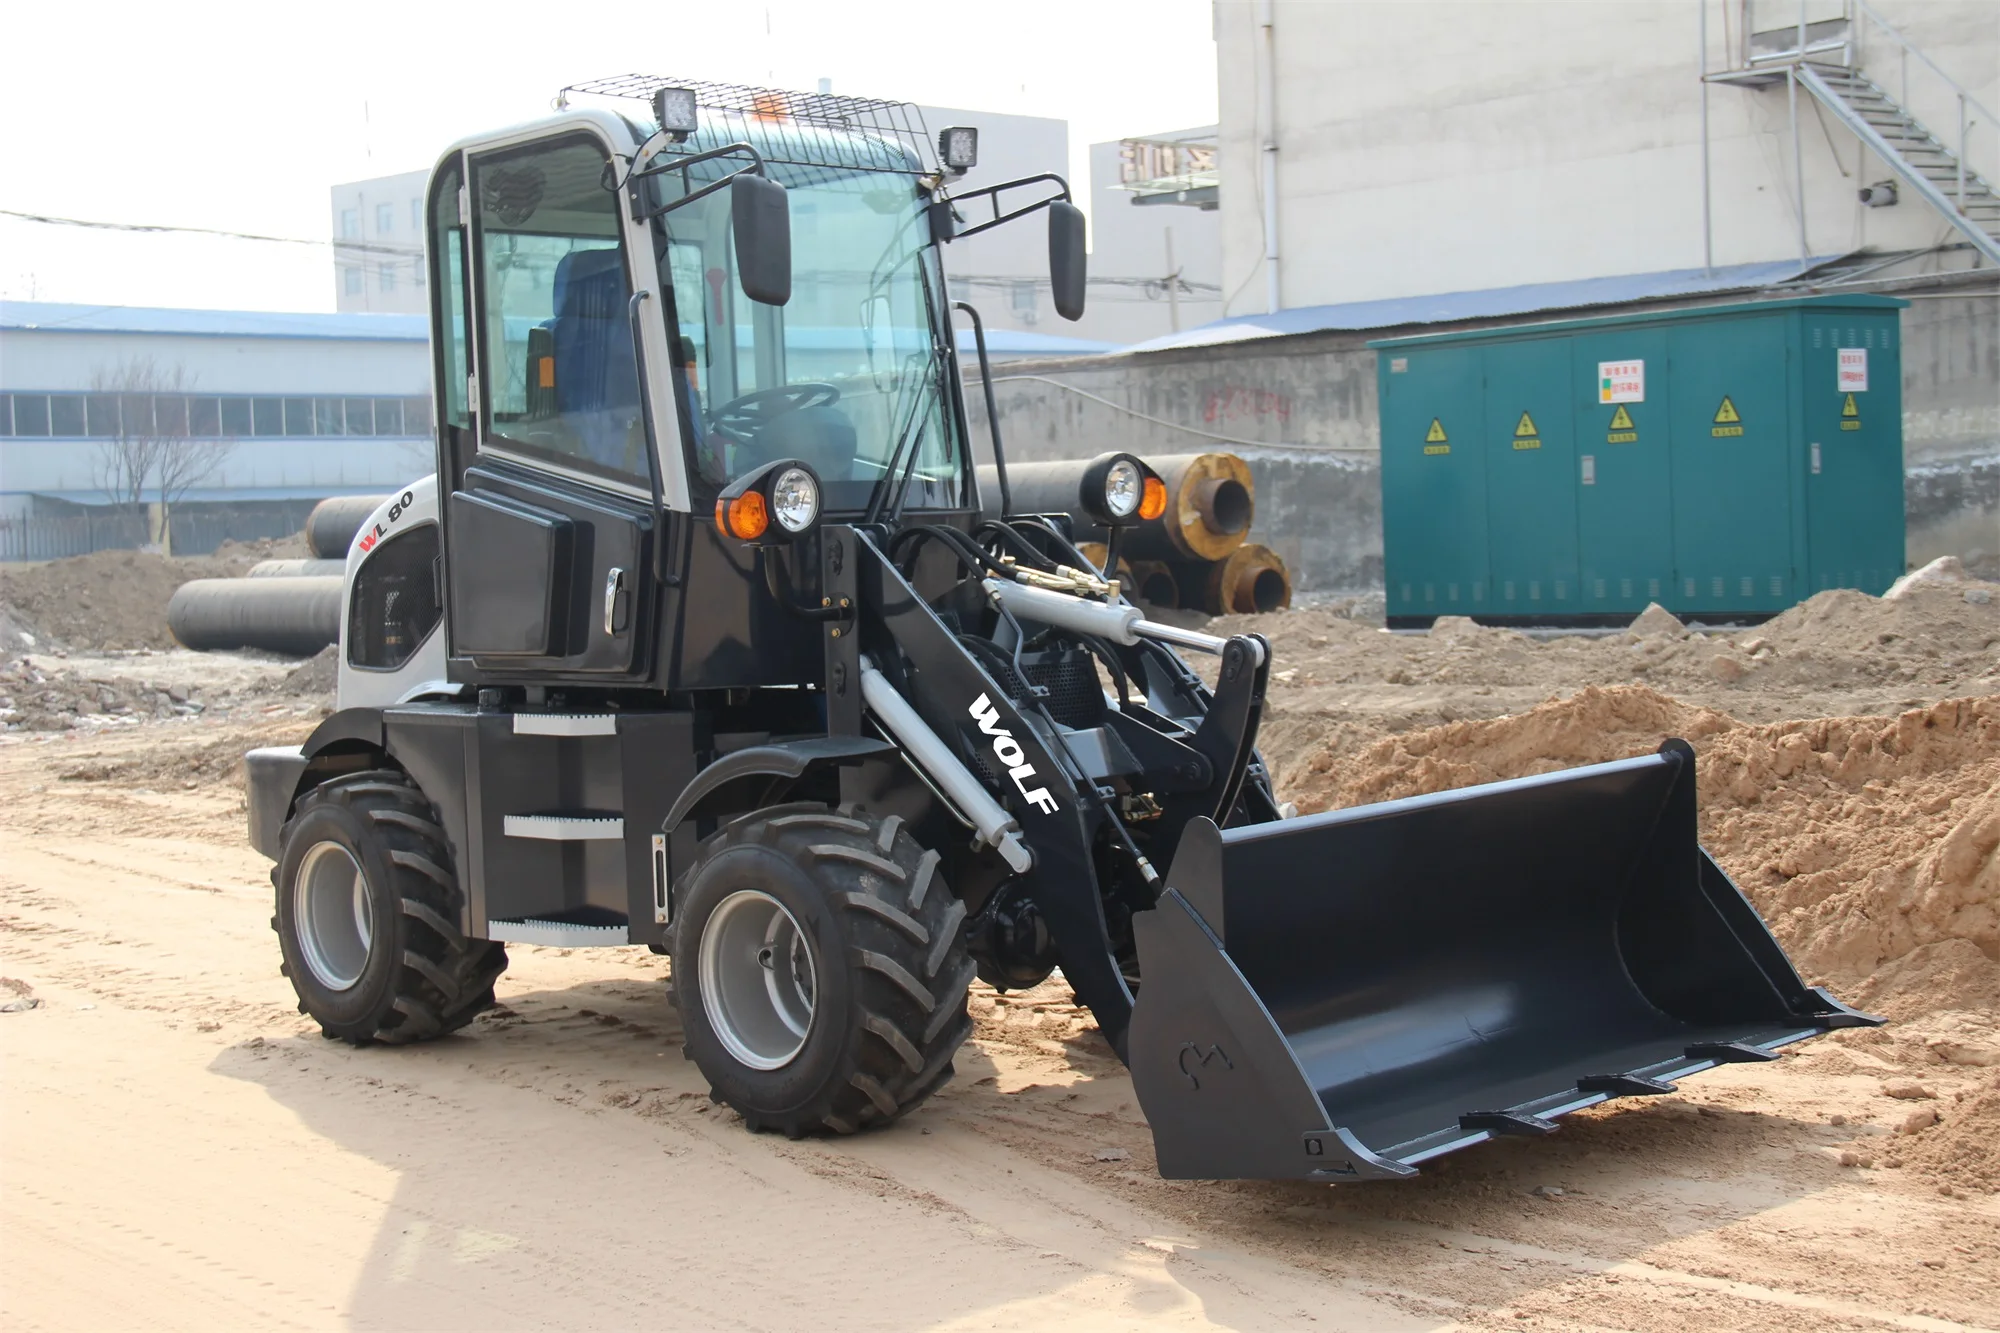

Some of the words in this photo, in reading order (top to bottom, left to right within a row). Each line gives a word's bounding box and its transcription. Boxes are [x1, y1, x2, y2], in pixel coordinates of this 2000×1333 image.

[359, 523, 388, 552] WL
[388, 491, 413, 523] 80
[968, 692, 1060, 815] WOLF
